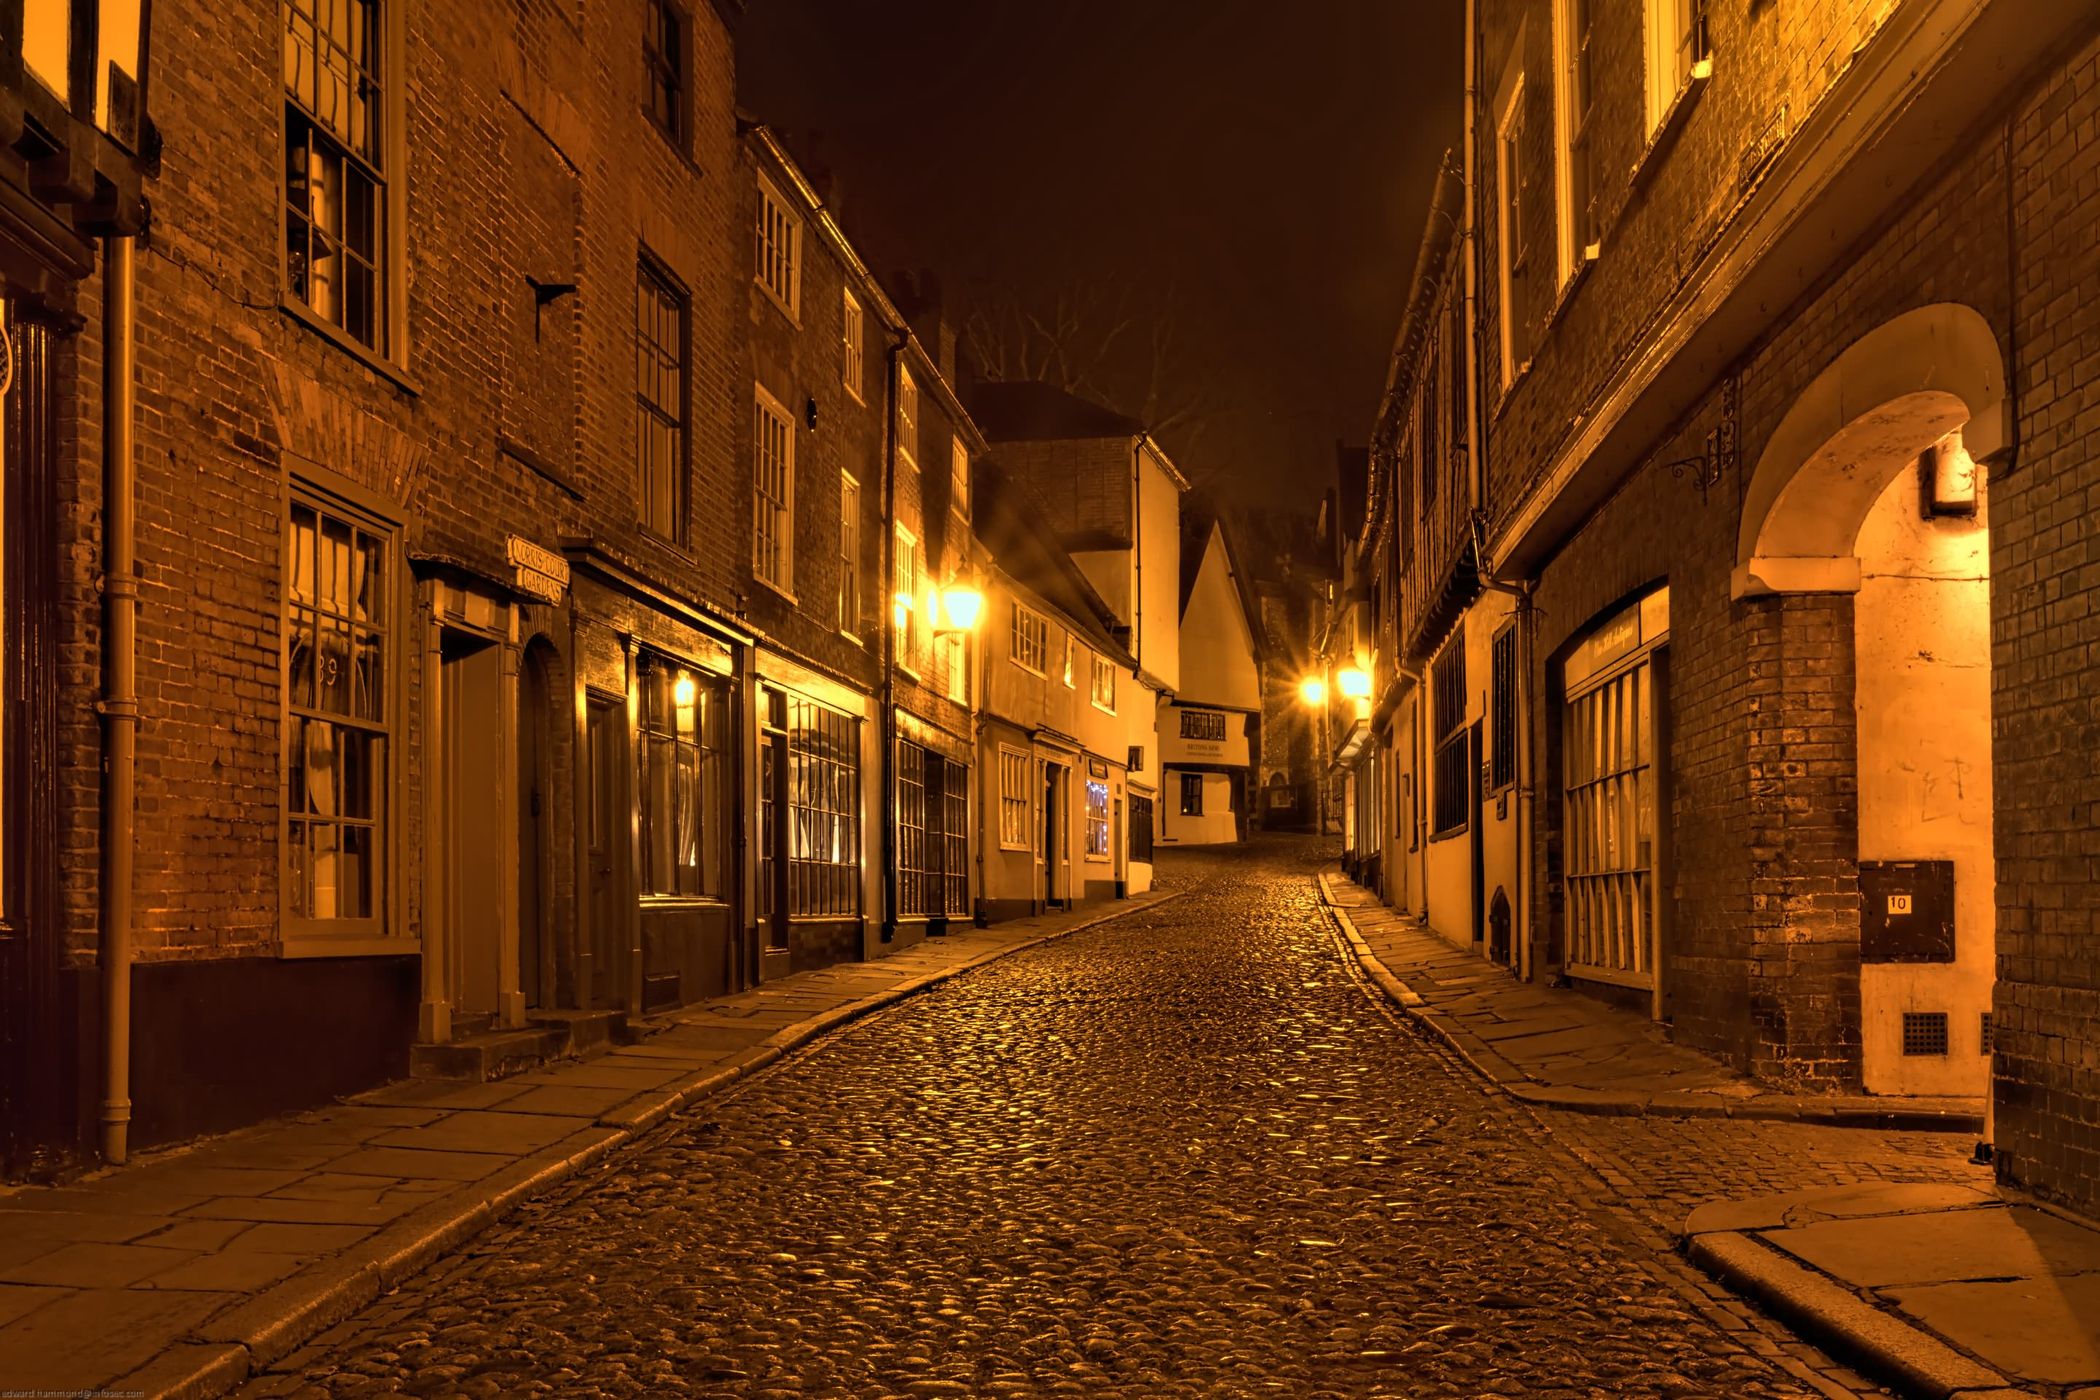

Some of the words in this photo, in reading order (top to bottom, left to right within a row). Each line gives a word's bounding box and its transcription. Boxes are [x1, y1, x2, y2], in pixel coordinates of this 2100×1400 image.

[515, 541, 543, 569] NORRIS
[545, 555, 569, 582] COURT
[525, 571, 561, 601] GARDENS
[1891, 896, 1906, 910] 10
